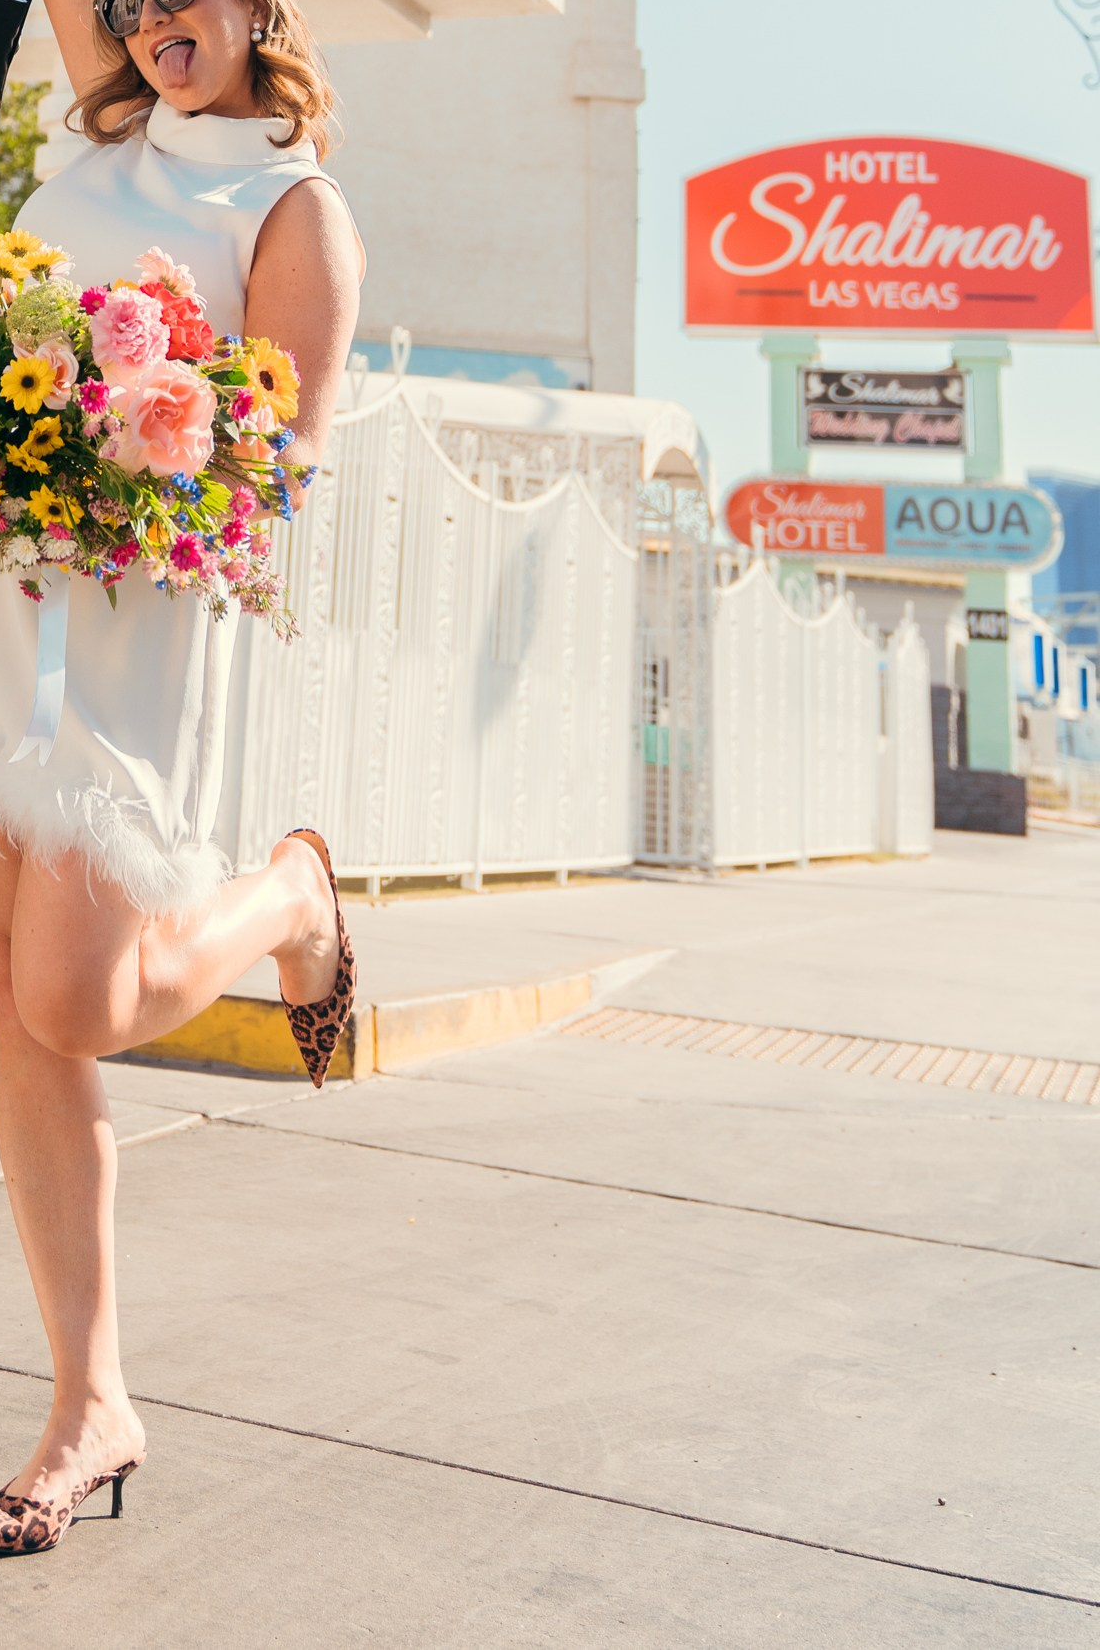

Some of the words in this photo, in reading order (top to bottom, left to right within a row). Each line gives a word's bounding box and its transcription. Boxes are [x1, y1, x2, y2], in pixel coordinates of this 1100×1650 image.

[825, 150, 939, 184] HOTEL
[710, 171, 1062, 277] Shalimar
[809, 280, 859, 307] LAS
[865, 281, 960, 310] VEGAS
[751, 484, 868, 522] Shalimar
[895, 496, 1031, 537] AQUA
[751, 518, 868, 551] HOTEL
